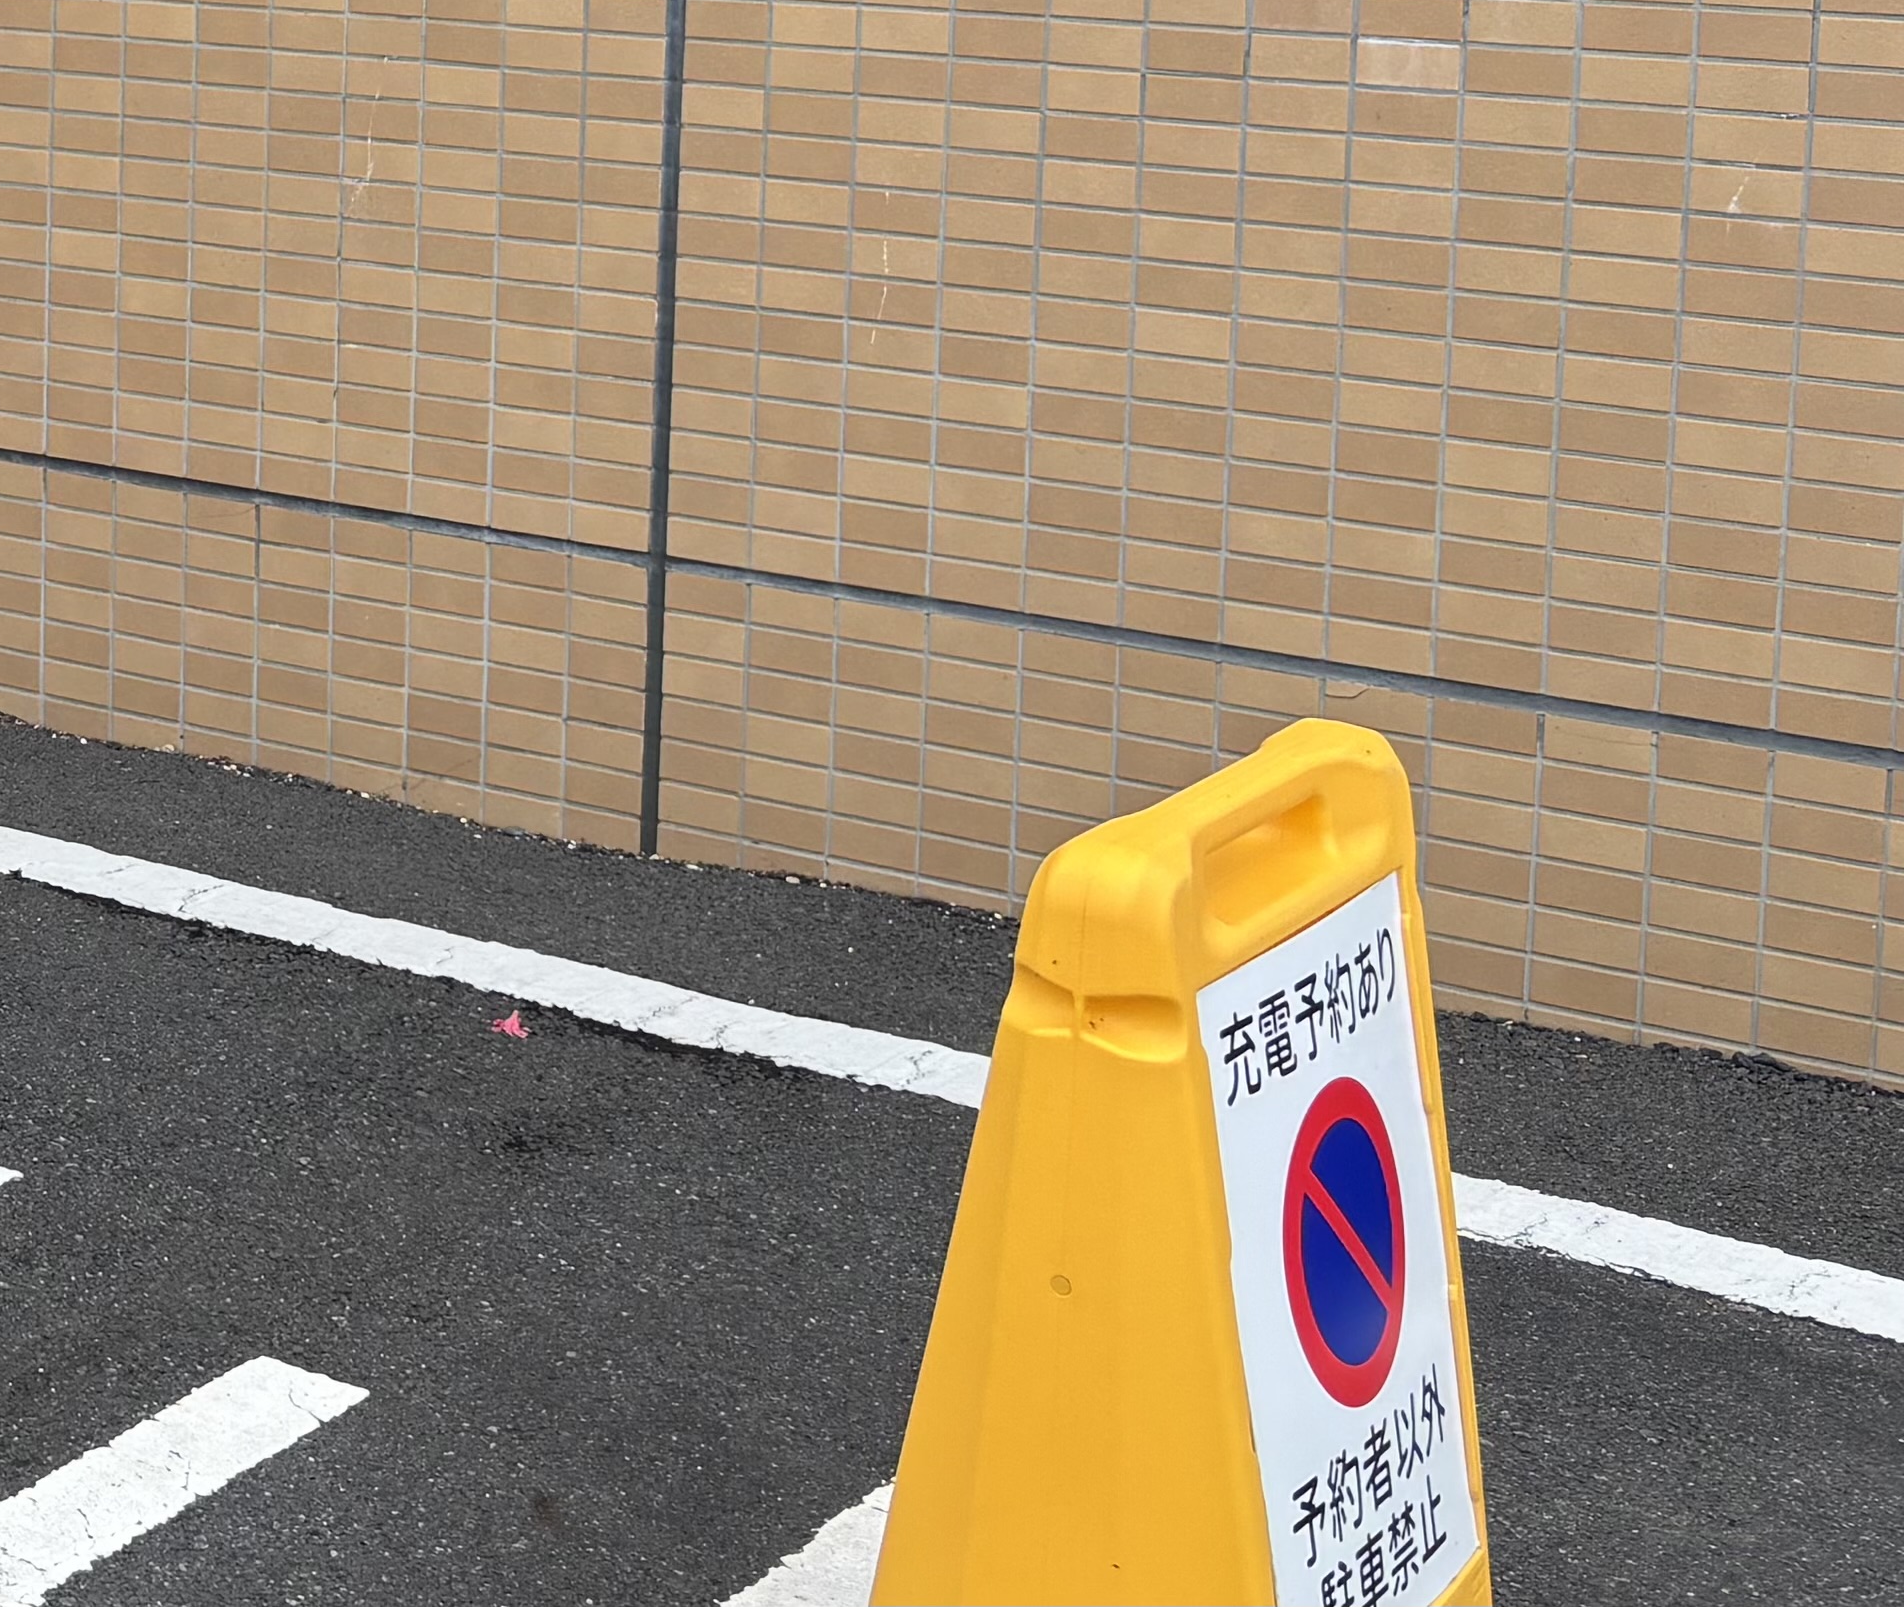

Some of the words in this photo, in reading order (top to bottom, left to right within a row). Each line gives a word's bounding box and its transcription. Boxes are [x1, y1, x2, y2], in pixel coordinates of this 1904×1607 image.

[1219, 927, 1397, 1106] 充電予約あり
[1291, 1362, 1447, 1569] 予約者以外
